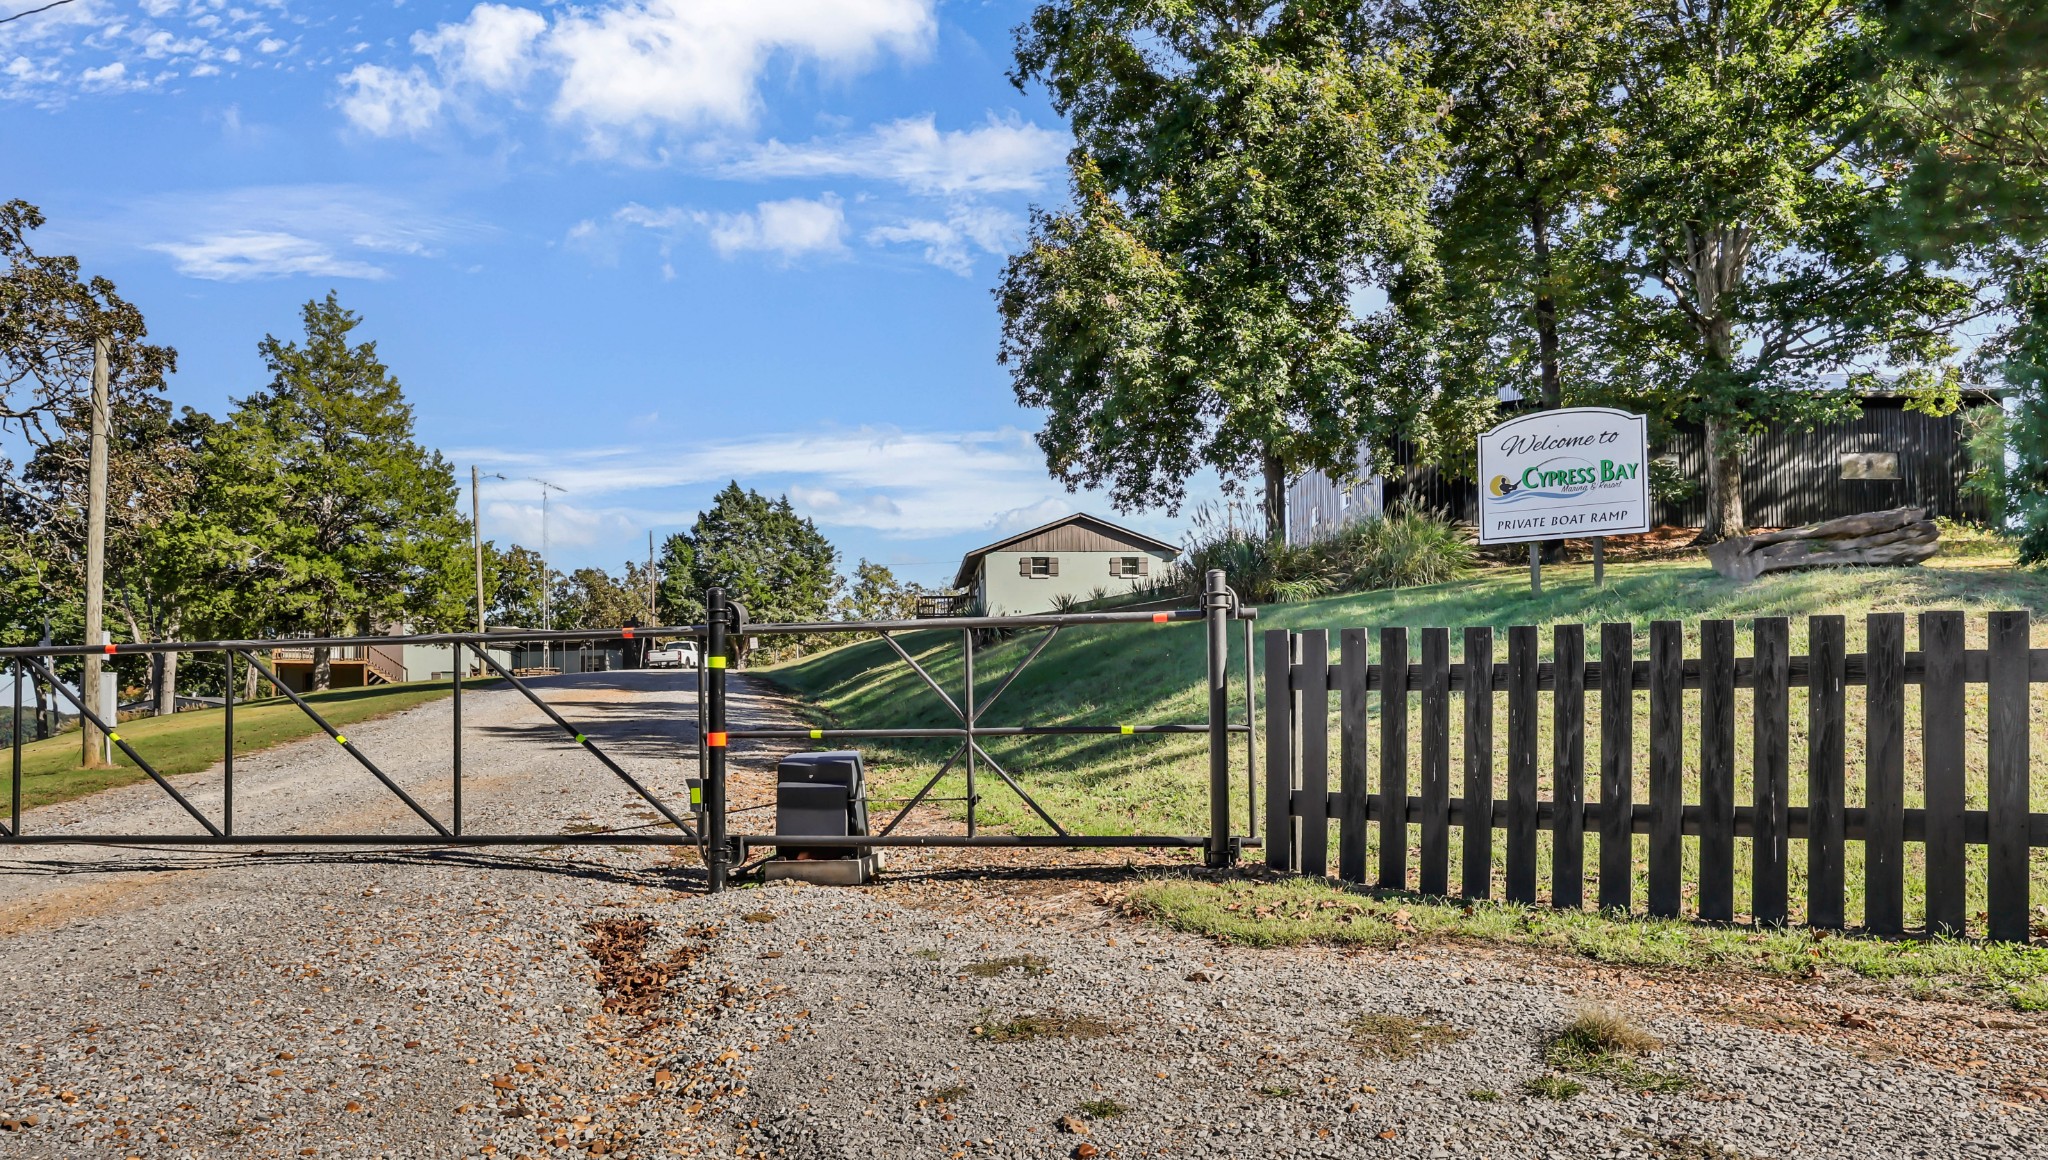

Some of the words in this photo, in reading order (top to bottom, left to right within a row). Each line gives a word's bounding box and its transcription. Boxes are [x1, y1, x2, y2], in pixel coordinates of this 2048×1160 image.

[1500, 433, 1596, 457] Welcome
[1598, 430, 1619, 444] to
[1522, 466, 1596, 489] CYPRESS
[1600, 459, 1640, 483] BAY
[1591, 483, 1597, 491] &
[1598, 481, 1622, 489] Resort
[1497, 517, 1545, 531] PRIVATE
[1551, 513, 1586, 526] BOAT
[1590, 510, 1628, 523] RAMP
